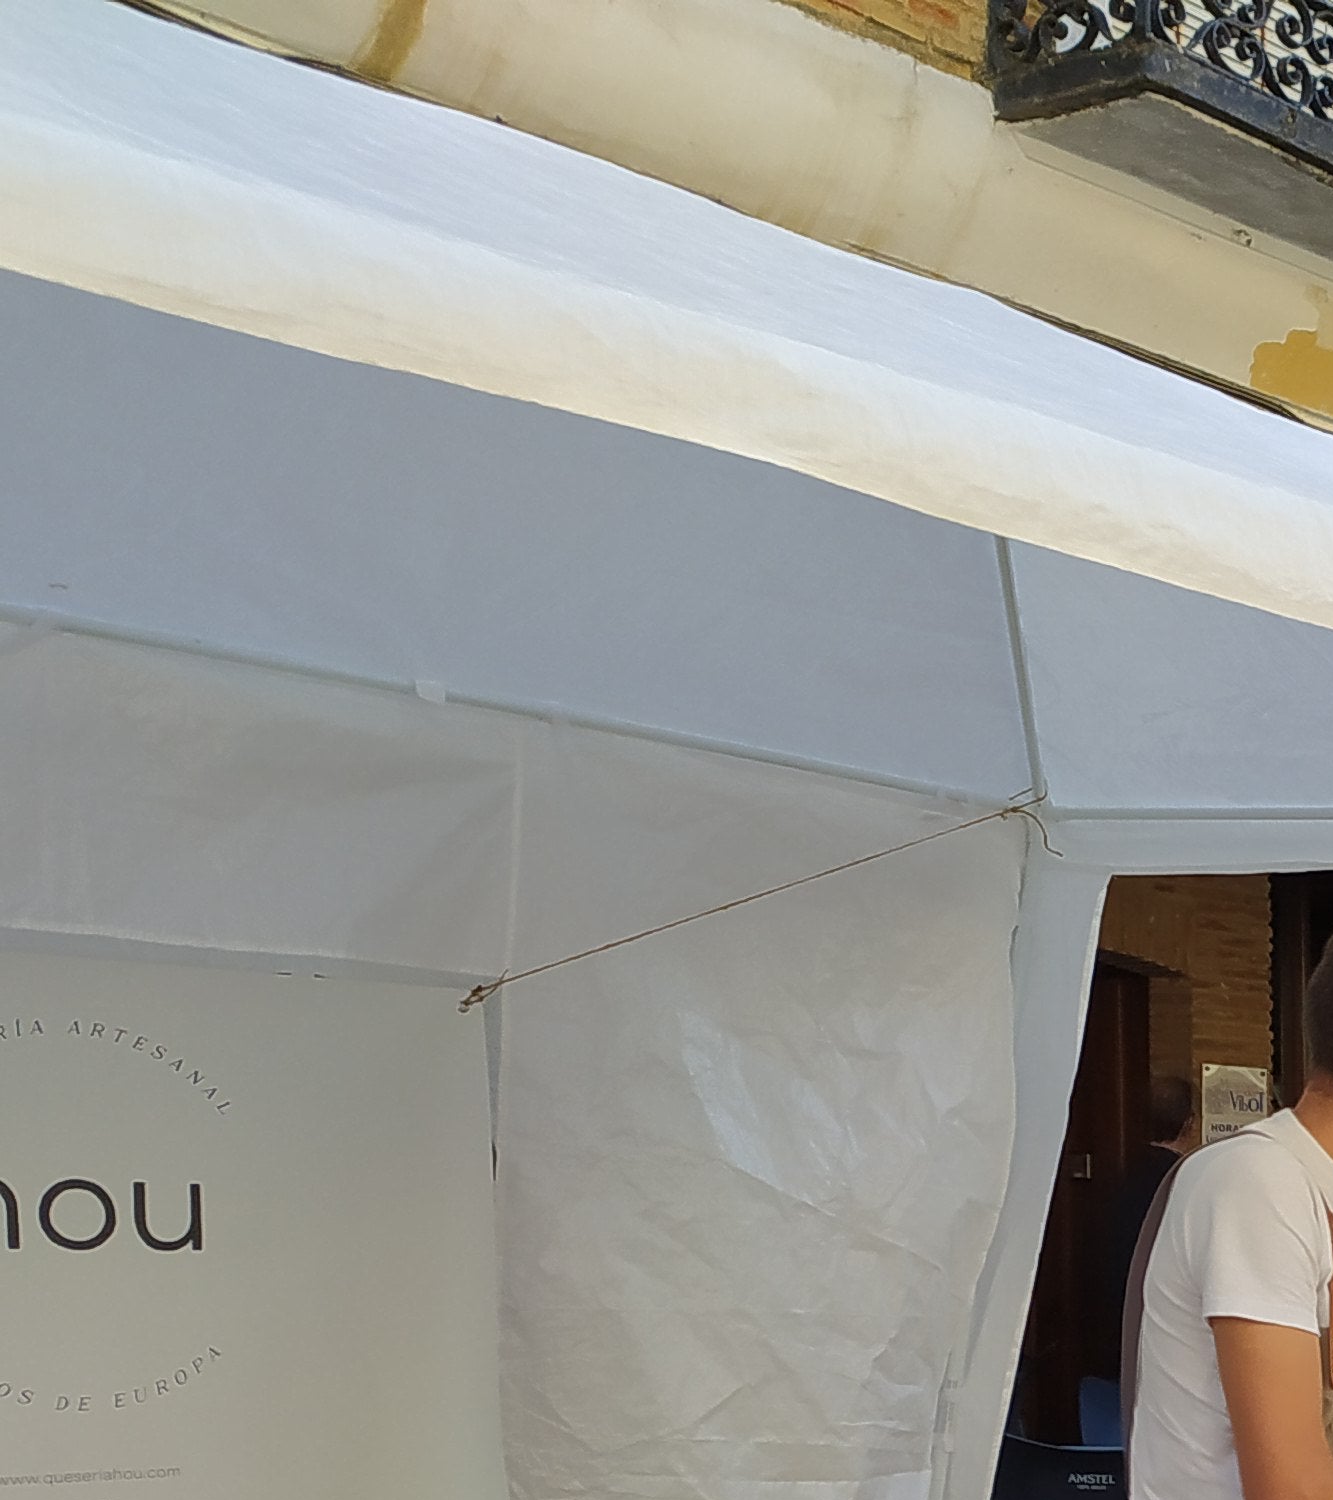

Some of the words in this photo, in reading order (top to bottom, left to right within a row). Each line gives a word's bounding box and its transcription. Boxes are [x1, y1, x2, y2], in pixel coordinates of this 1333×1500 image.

[67, 1020, 231, 1115] ARTESANAL
[55, 1396, 92, 1412] DE
[113, 1346, 222, 1409] EUROPA
[1067, 1473, 1116, 1485] AMSTEL
